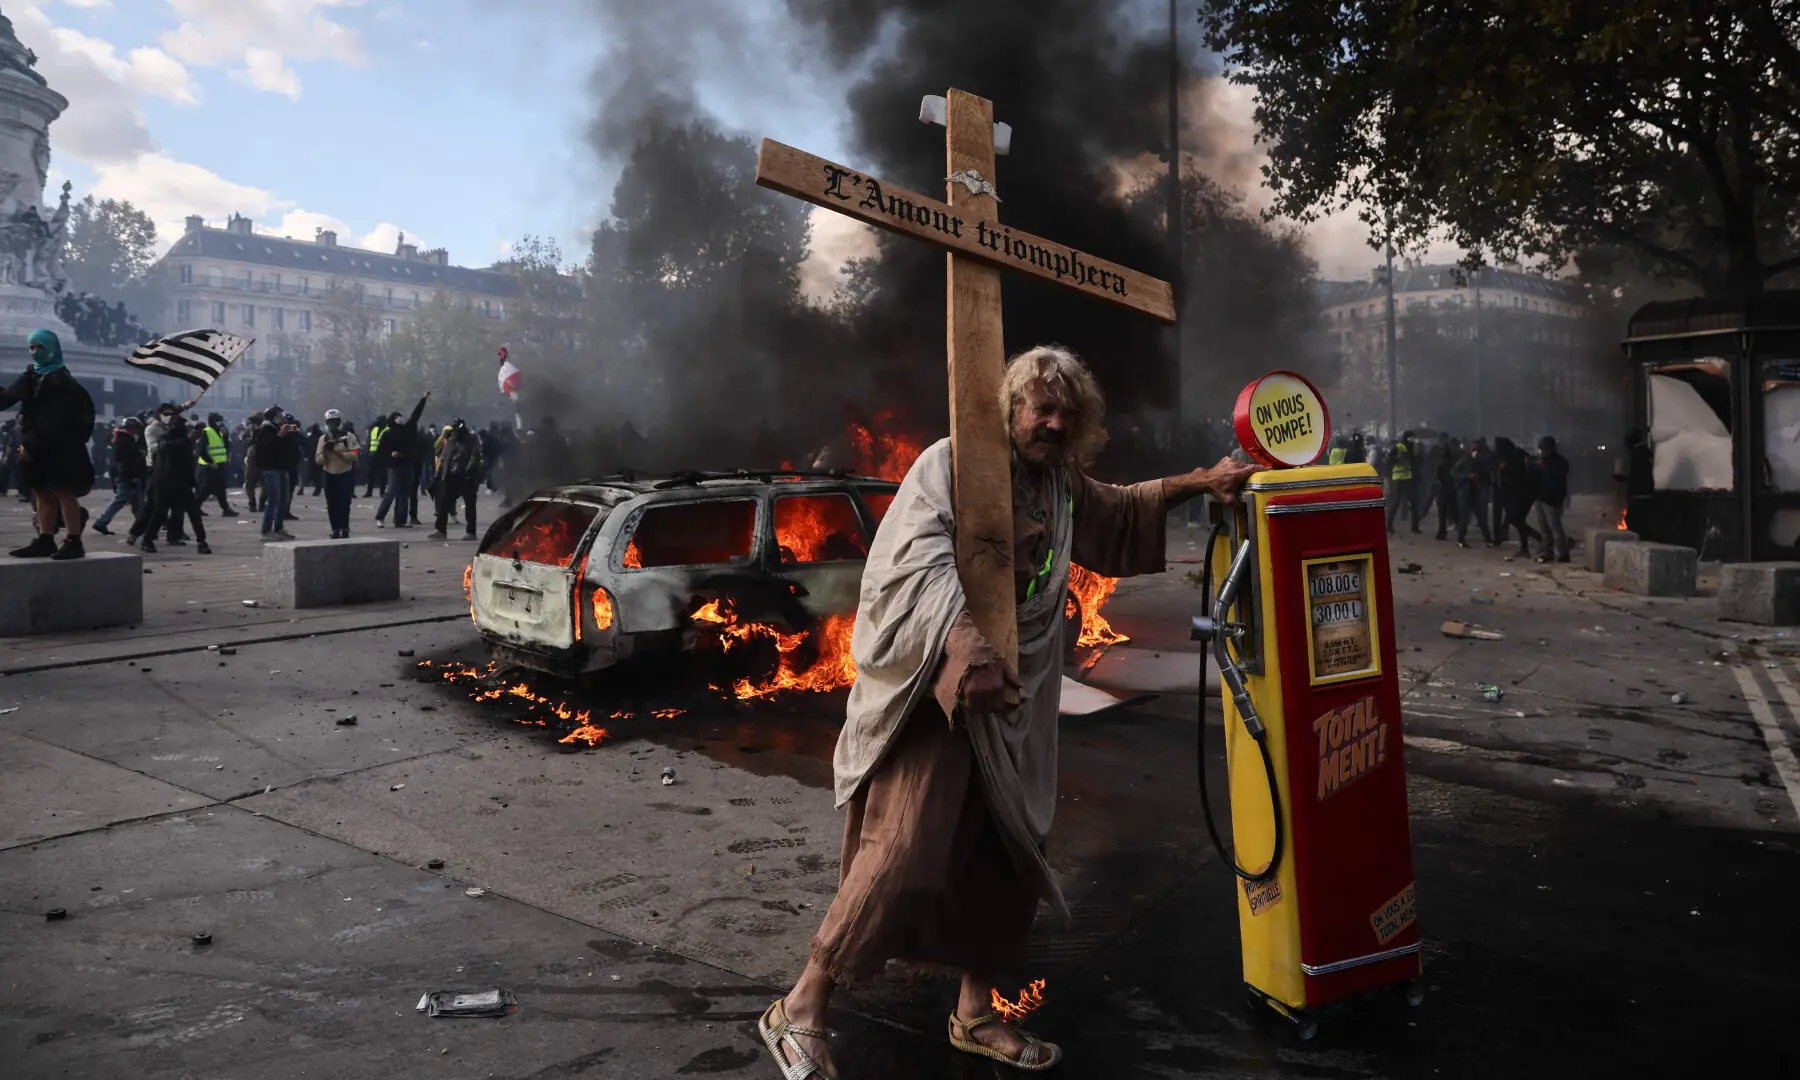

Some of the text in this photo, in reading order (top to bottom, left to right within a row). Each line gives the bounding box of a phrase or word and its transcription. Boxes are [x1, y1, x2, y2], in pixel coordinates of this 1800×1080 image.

[823, 164, 1129, 298] L'Amour triomphera
[1256, 393, 1304, 425] ON VOUS
[1264, 412, 1312, 448] POMPE!
[1313, 696, 1378, 757] TOTAL
[1318, 723, 1387, 800] MENT!
[1373, 913, 1384, 928] ON
[1383, 899, 1400, 919] VOUS
[1379, 917, 1400, 940] TOTAL
